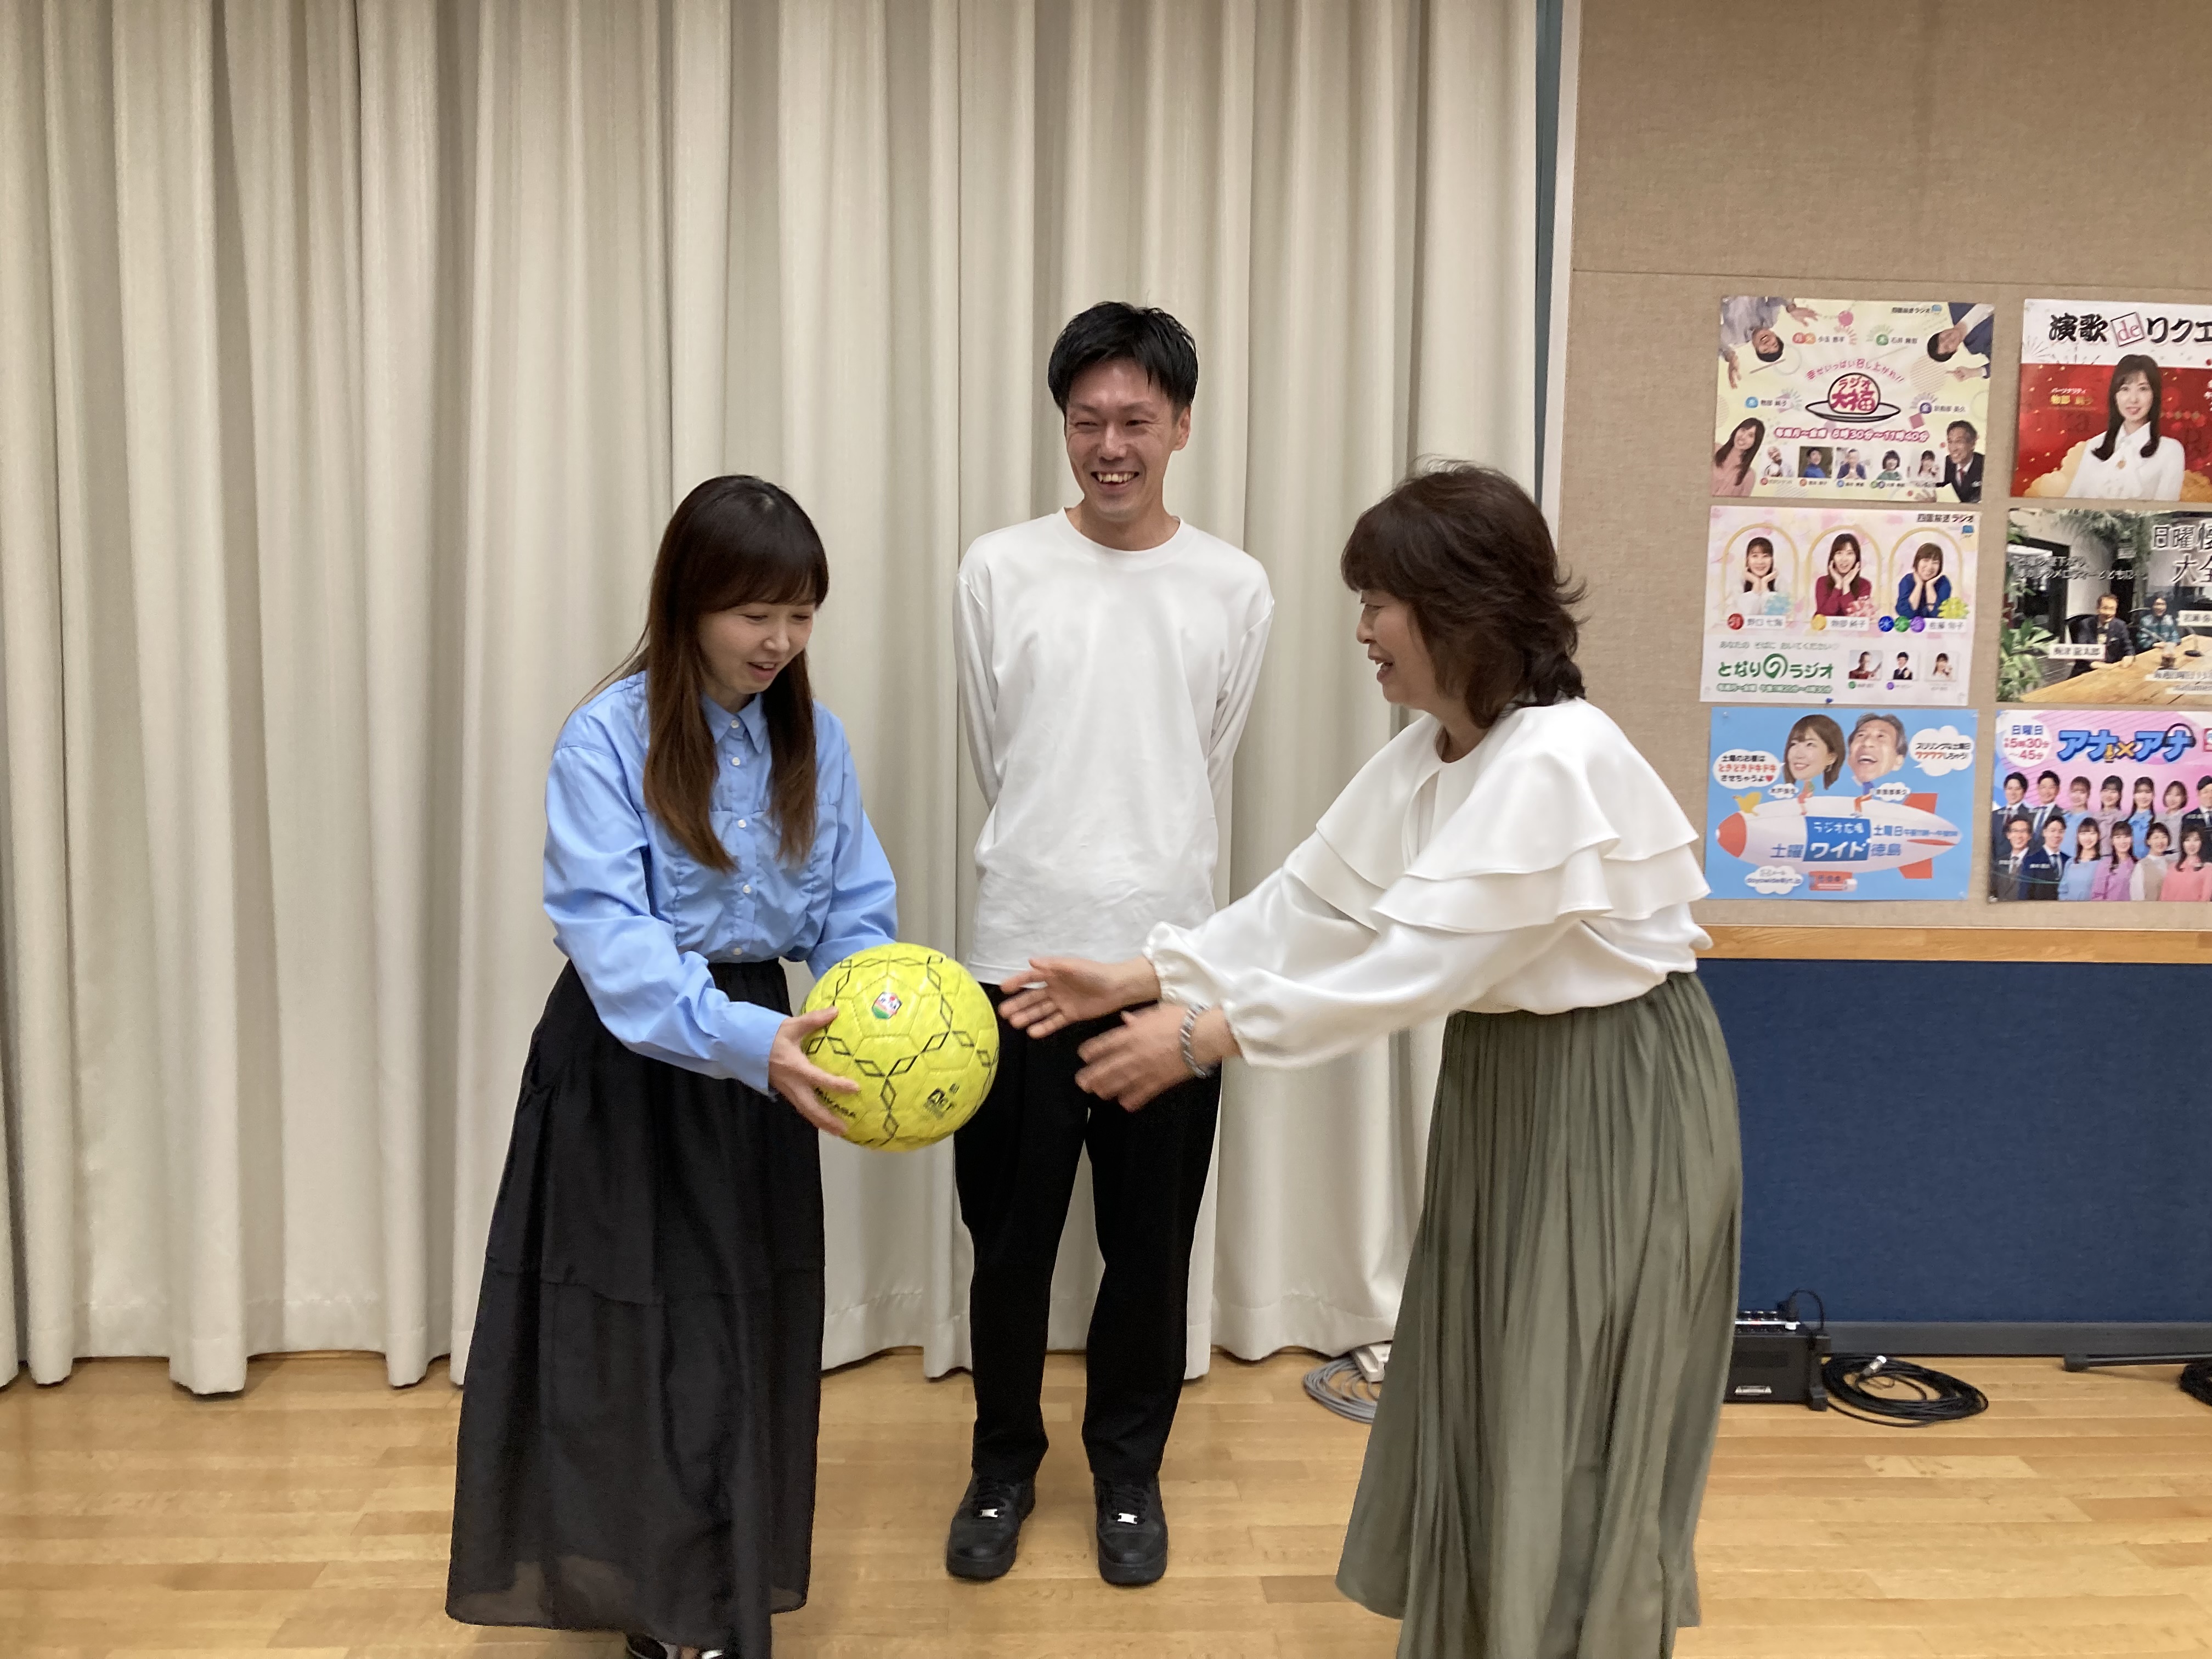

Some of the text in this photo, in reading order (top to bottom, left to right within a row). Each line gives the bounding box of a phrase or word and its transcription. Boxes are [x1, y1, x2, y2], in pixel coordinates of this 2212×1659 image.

[1830, 388, 1875, 411] 大福
[2012, 725, 2043, 735] 日曜日
[1872, 825, 1903, 836] 土曜日
